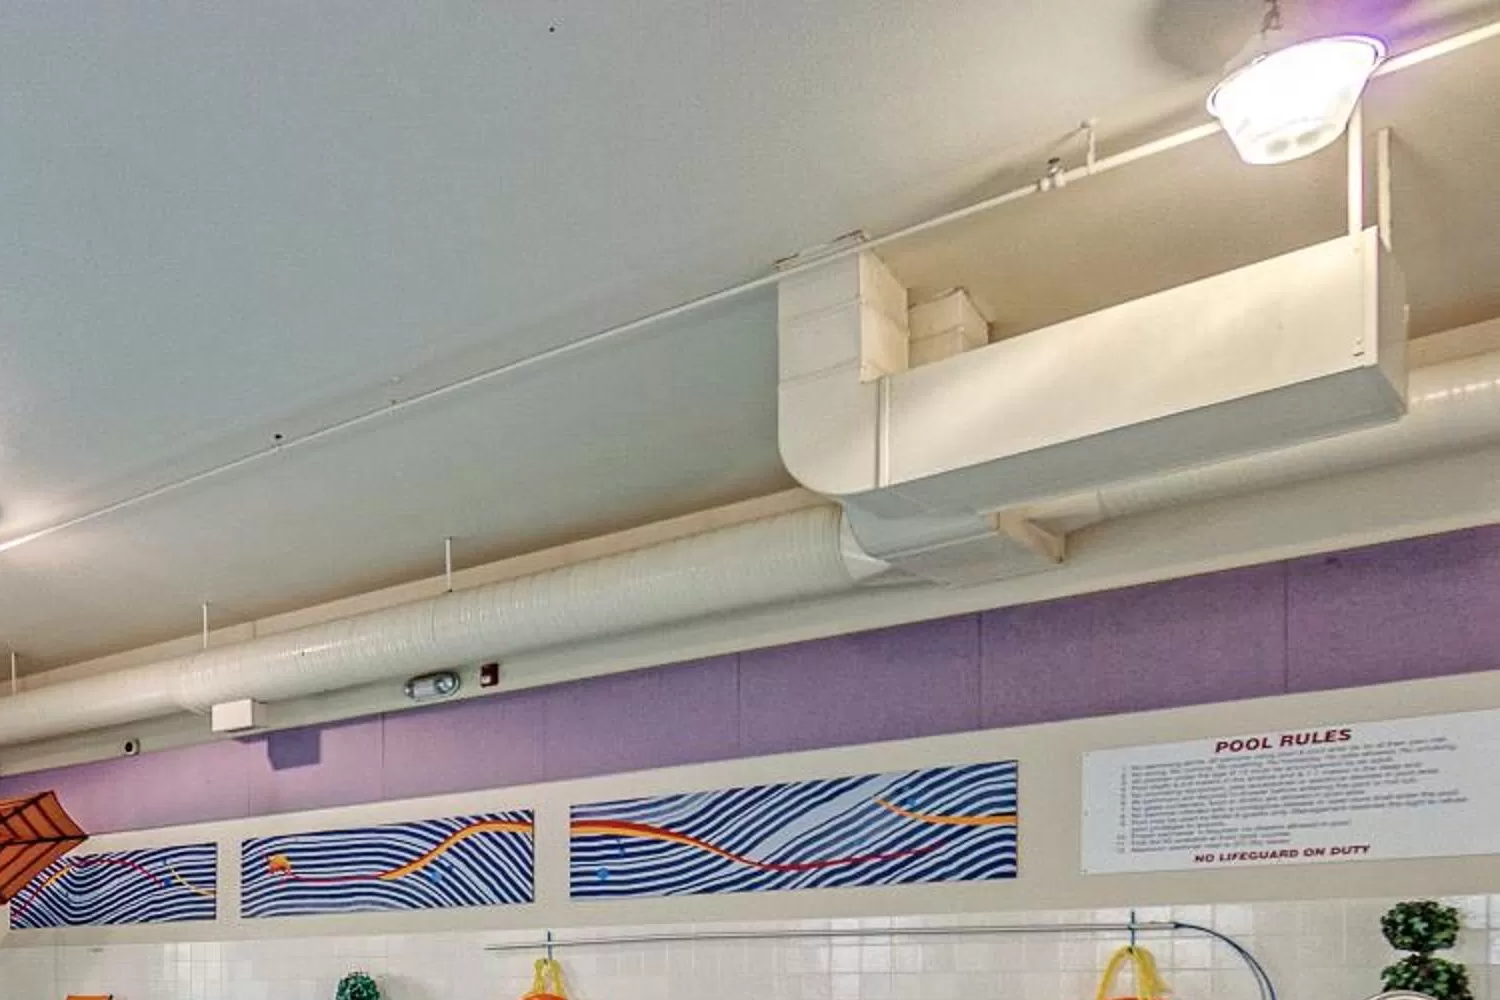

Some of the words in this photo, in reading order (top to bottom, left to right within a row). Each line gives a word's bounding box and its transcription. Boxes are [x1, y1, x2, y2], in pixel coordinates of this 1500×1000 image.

[1215, 737, 1273, 753] POOL
[1279, 728, 1352, 747] RULES
[1195, 853, 1215, 863] NO
[1219, 848, 1299, 861] LIFEGUARD
[1303, 847, 1325, 857] ON
[1330, 844, 1370, 856] DUTY
